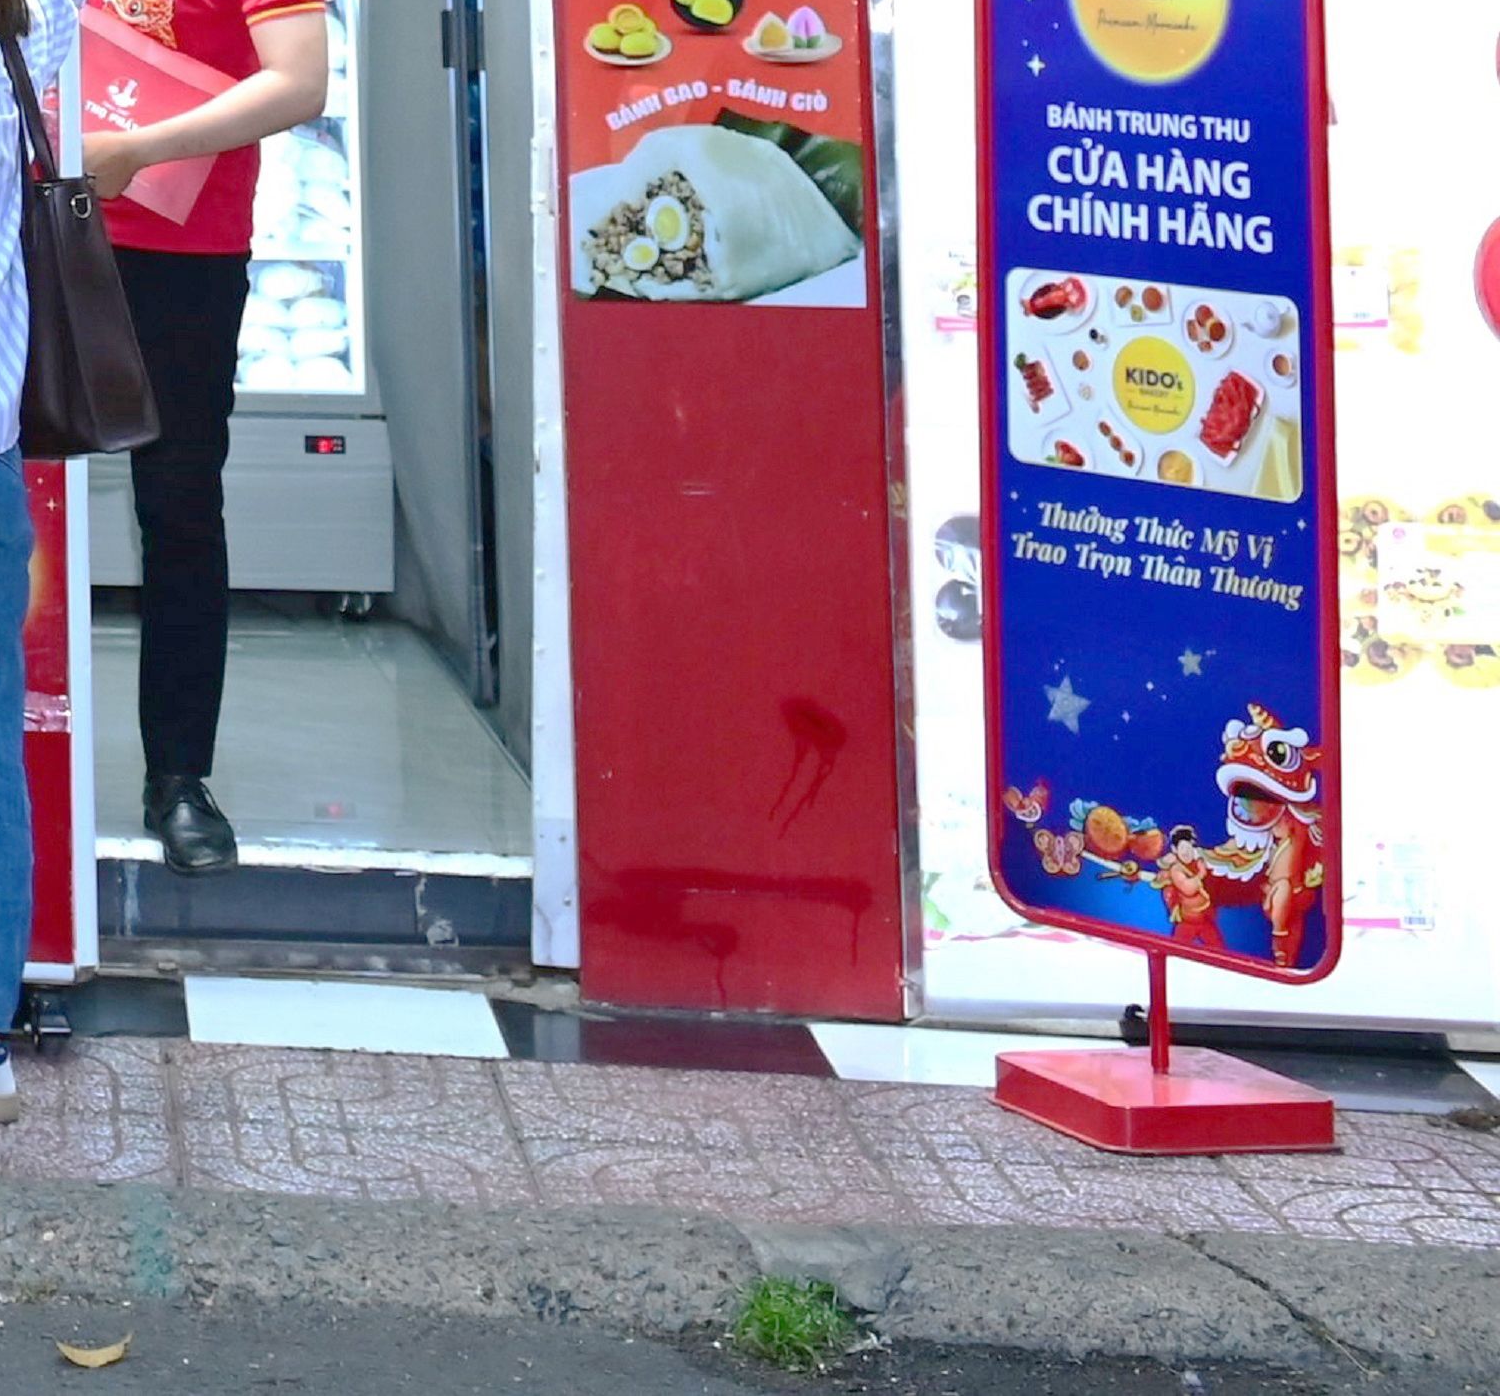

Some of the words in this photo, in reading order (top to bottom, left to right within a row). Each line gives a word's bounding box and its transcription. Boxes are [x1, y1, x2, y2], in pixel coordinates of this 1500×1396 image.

[1047, 103, 1112, 131] BÁNH
[1116, 109, 1197, 139] TRUNG
[1200, 116, 1250, 142] THU
[1047, 140, 1127, 187] CỬA
[1138, 150, 1251, 199] HÀNG
[1027, 194, 1148, 241] CHÍNH
[1159, 205, 1274, 253] HÃNG
[1124, 366, 1183, 392] KIDO's
[1038, 501, 1127, 544] Thưởng
[1134, 516, 1196, 552] Thức
[1203, 528, 1239, 564] Mỹ
[1246, 533, 1273, 568] Vị
[1013, 531, 1068, 565] Trao
[1076, 542, 1132, 579] Trọn
[1141, 552, 1203, 590] Thân
[1210, 566, 1303, 610] Thương
